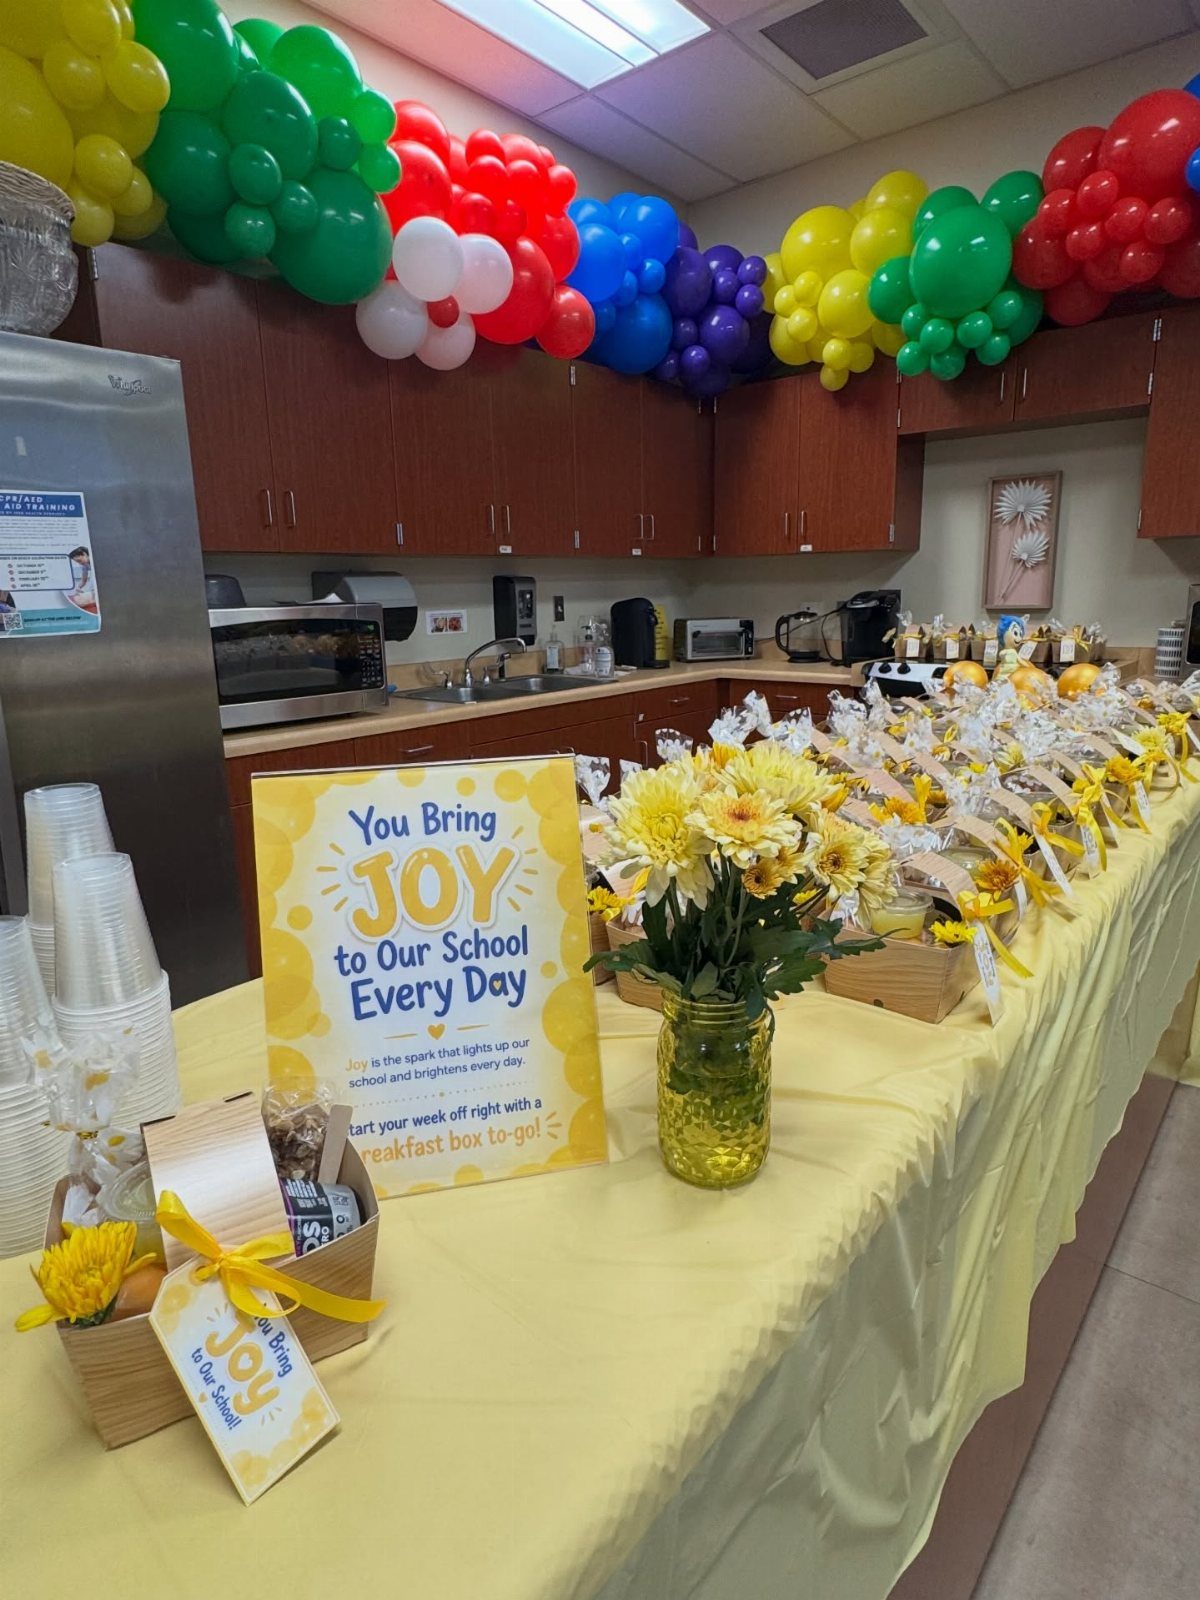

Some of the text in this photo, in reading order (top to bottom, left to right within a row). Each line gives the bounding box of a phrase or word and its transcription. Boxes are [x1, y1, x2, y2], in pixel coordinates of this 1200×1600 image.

[27, 503, 76, 511] TRAINING
[348, 802, 496, 846] You Bring
[351, 844, 516, 939] JOY
[333, 924, 528, 976] to Our School
[350, 965, 526, 1021] Every Day
[345, 1039, 530, 1073] Joy is the spark that lights up our
[349, 1056, 526, 1088] school and brightens every day.
[349, 1097, 542, 1136] tart your week off right with a
[361, 1116, 541, 1163] reakfast box to-go!
[254, 1316, 292, 1378] ou Bring
[191, 1347, 242, 1430] to Our School!
